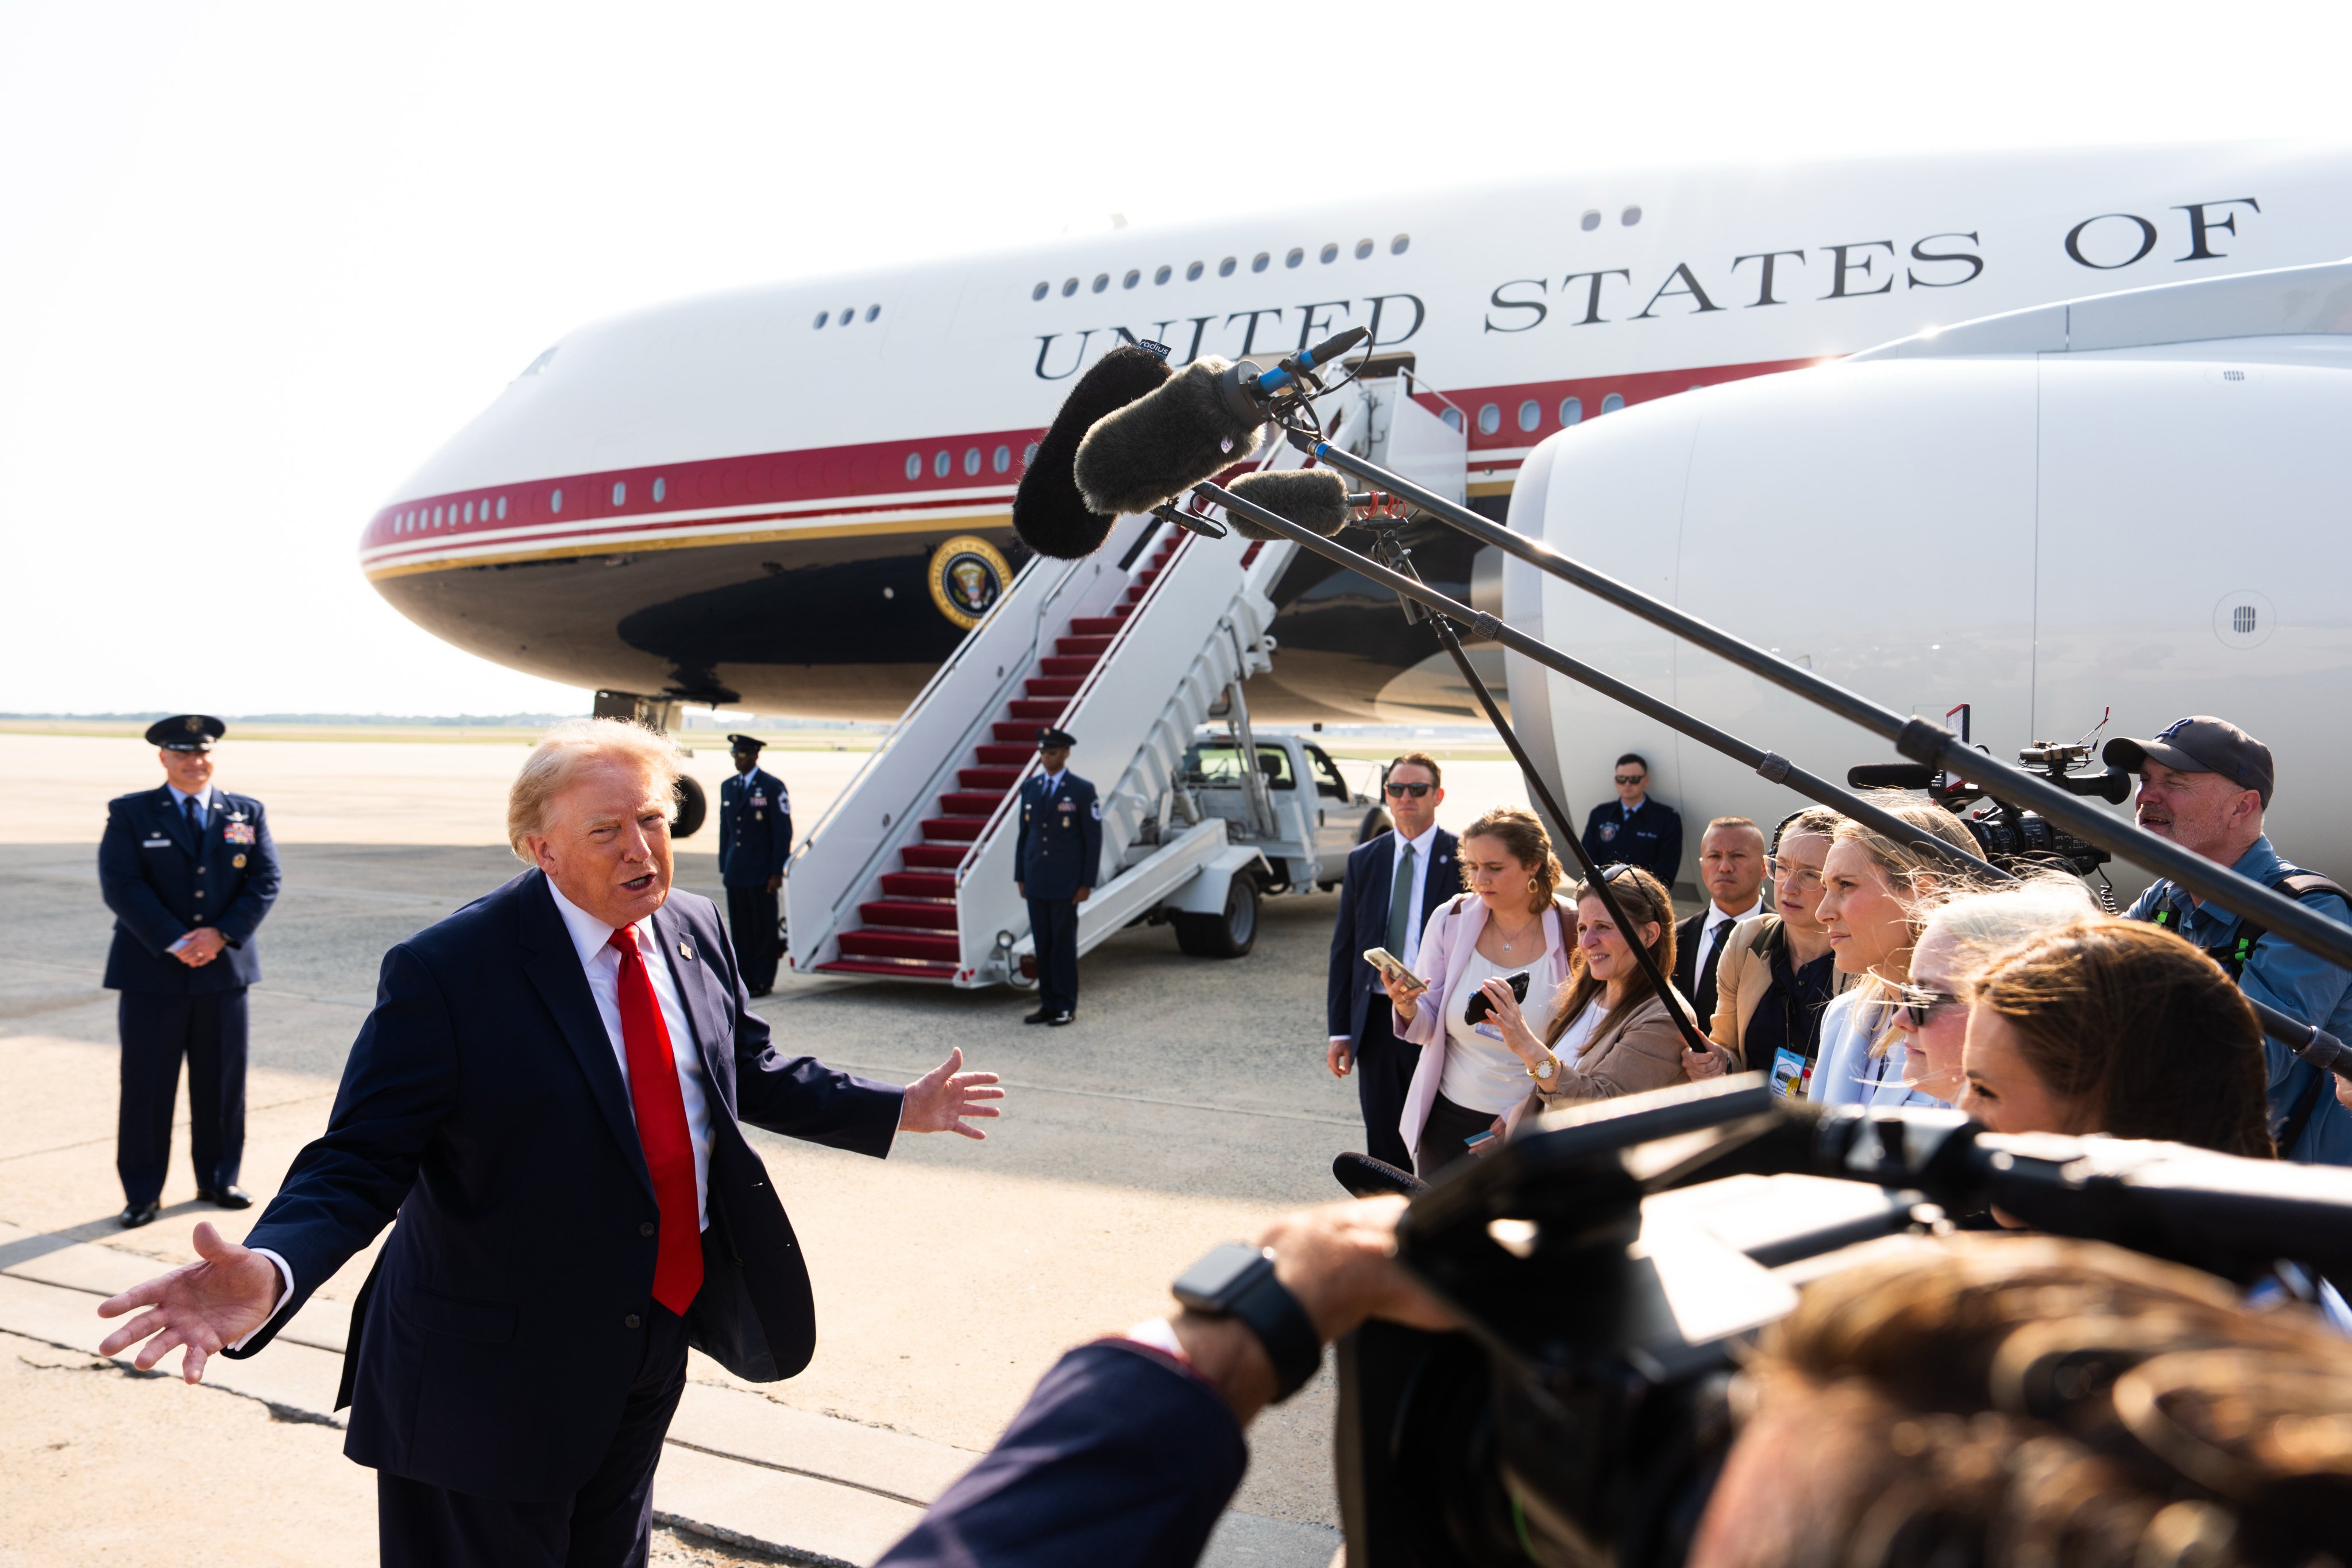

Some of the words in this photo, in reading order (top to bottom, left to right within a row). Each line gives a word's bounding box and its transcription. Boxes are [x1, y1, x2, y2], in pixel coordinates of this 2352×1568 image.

[1484, 231, 1984, 334] STATES
[2064, 197, 2262, 270] OF
[1139, 341, 1169, 355] radius
[1359, 1157, 1415, 1188] SENNHEISER
